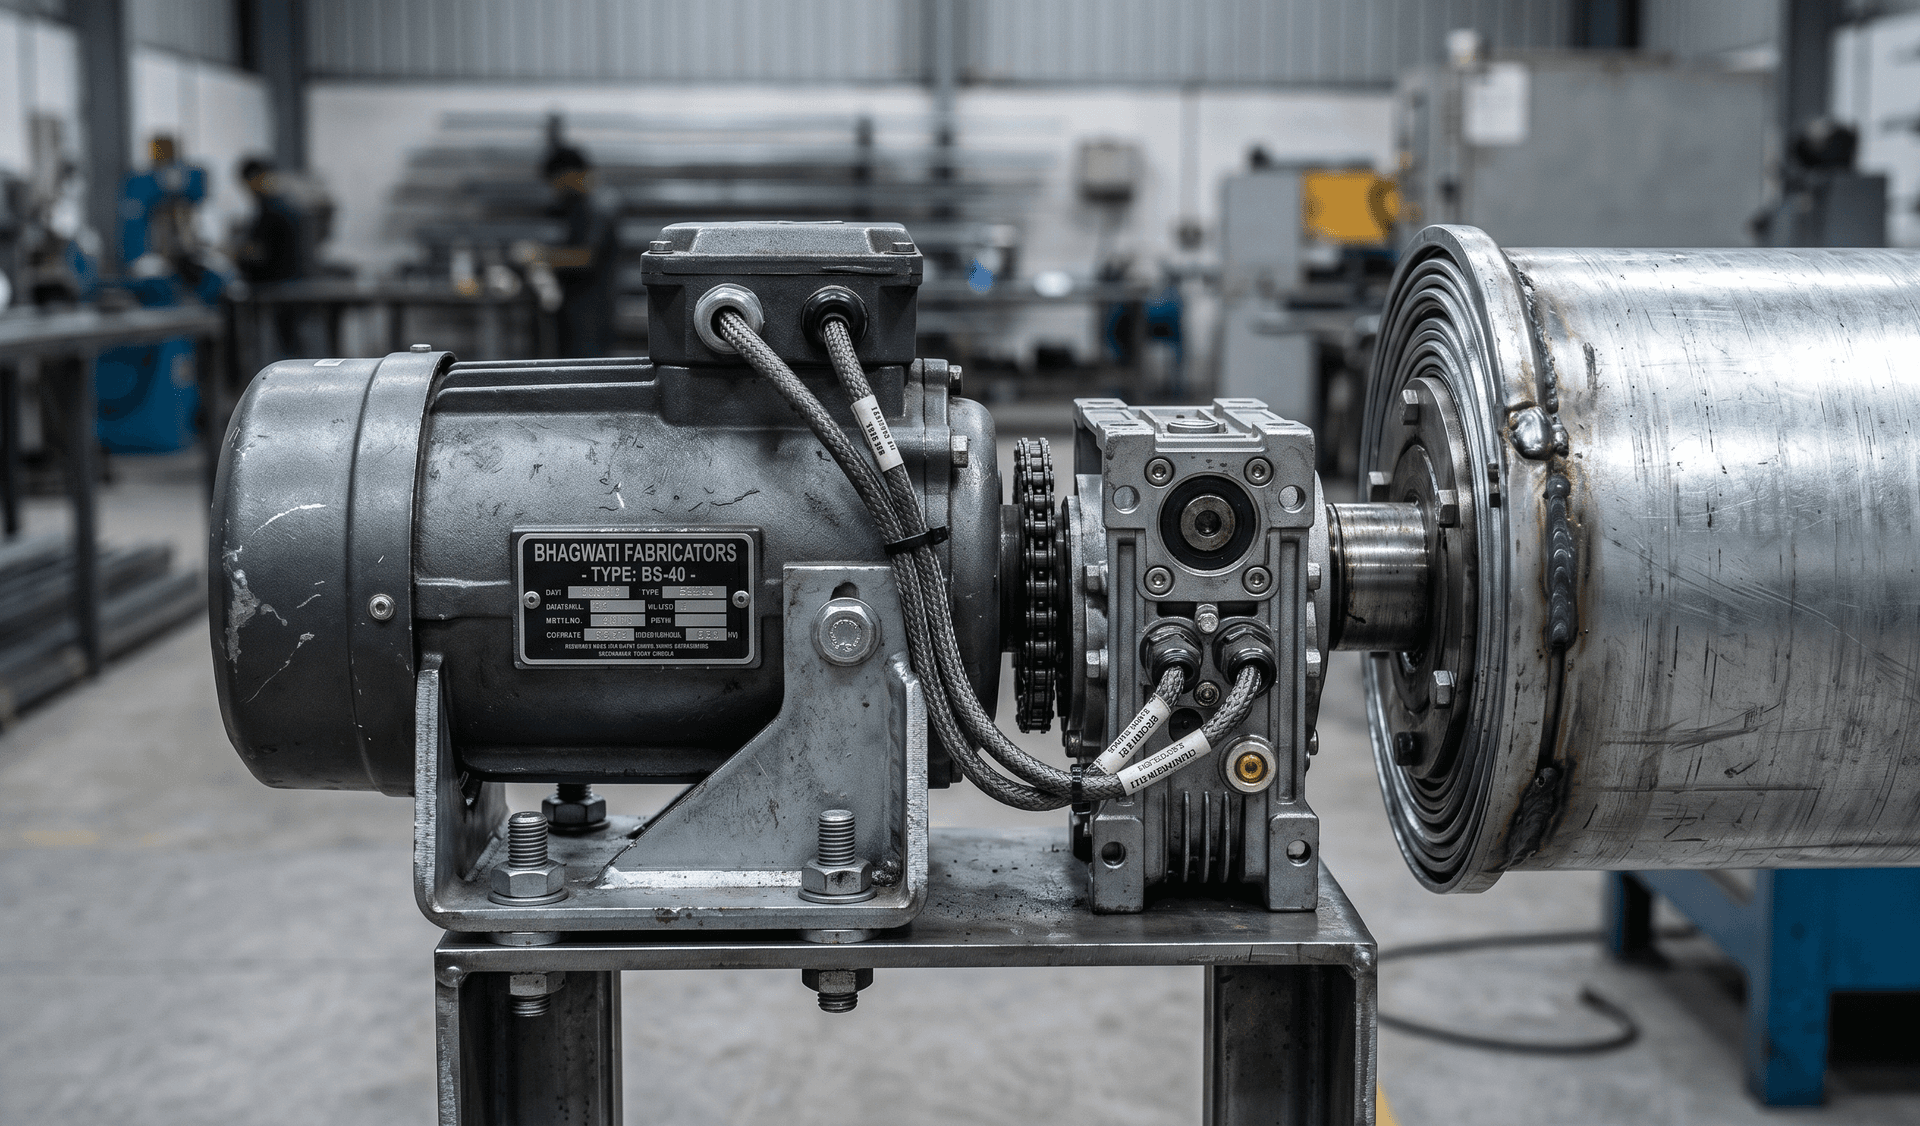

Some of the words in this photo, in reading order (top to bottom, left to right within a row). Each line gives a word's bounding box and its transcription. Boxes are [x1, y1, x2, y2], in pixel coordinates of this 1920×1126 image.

[534, 543, 620, 562] BHAGWATI
[624, 543, 737, 562] FABRICATORS
[591, 566, 637, 582] TYPE:
[641, 566, 686, 582] BS-40
[641, 588, 659, 596] TYPE
